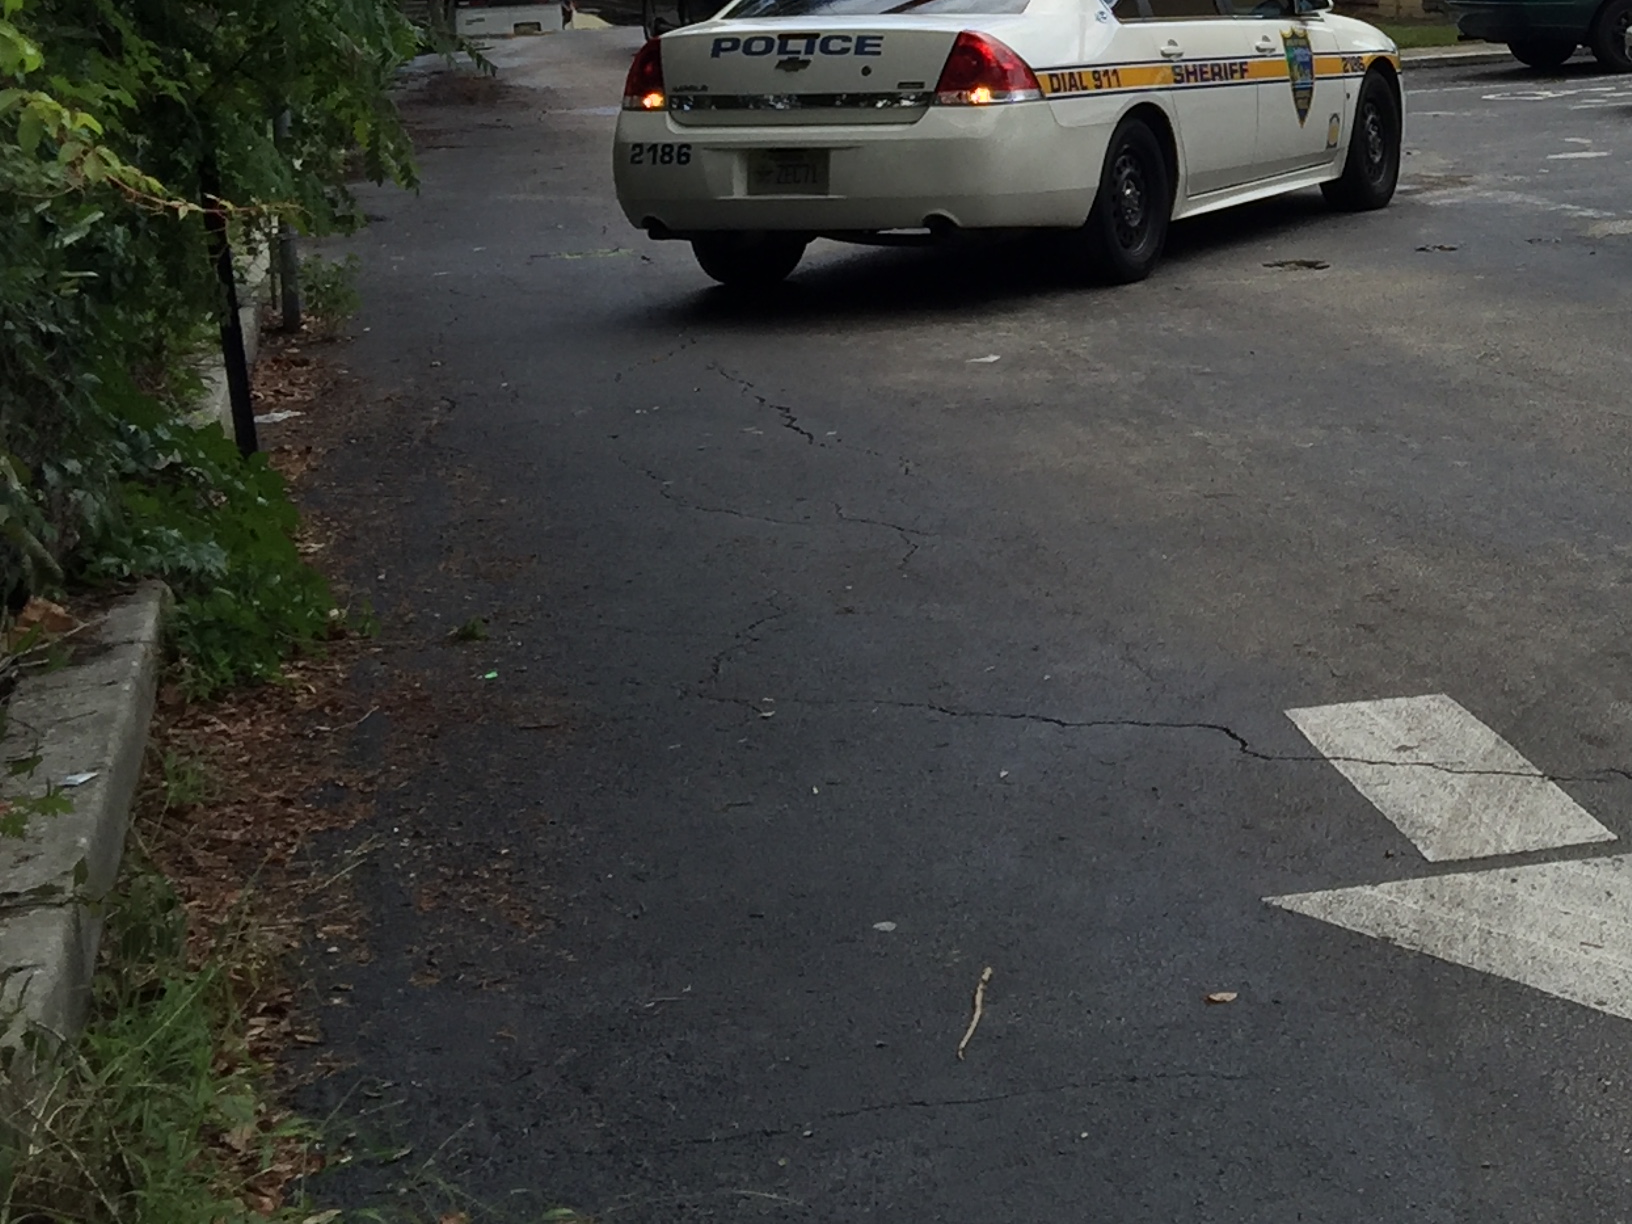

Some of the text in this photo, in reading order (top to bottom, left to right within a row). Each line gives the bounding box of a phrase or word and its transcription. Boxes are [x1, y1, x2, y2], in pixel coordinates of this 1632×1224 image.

[710, 34, 884, 59] POLICE
[1048, 68, 1122, 93] DIAL 911
[1172, 61, 1249, 85] SHERIFF
[630, 142, 692, 166] 2186
